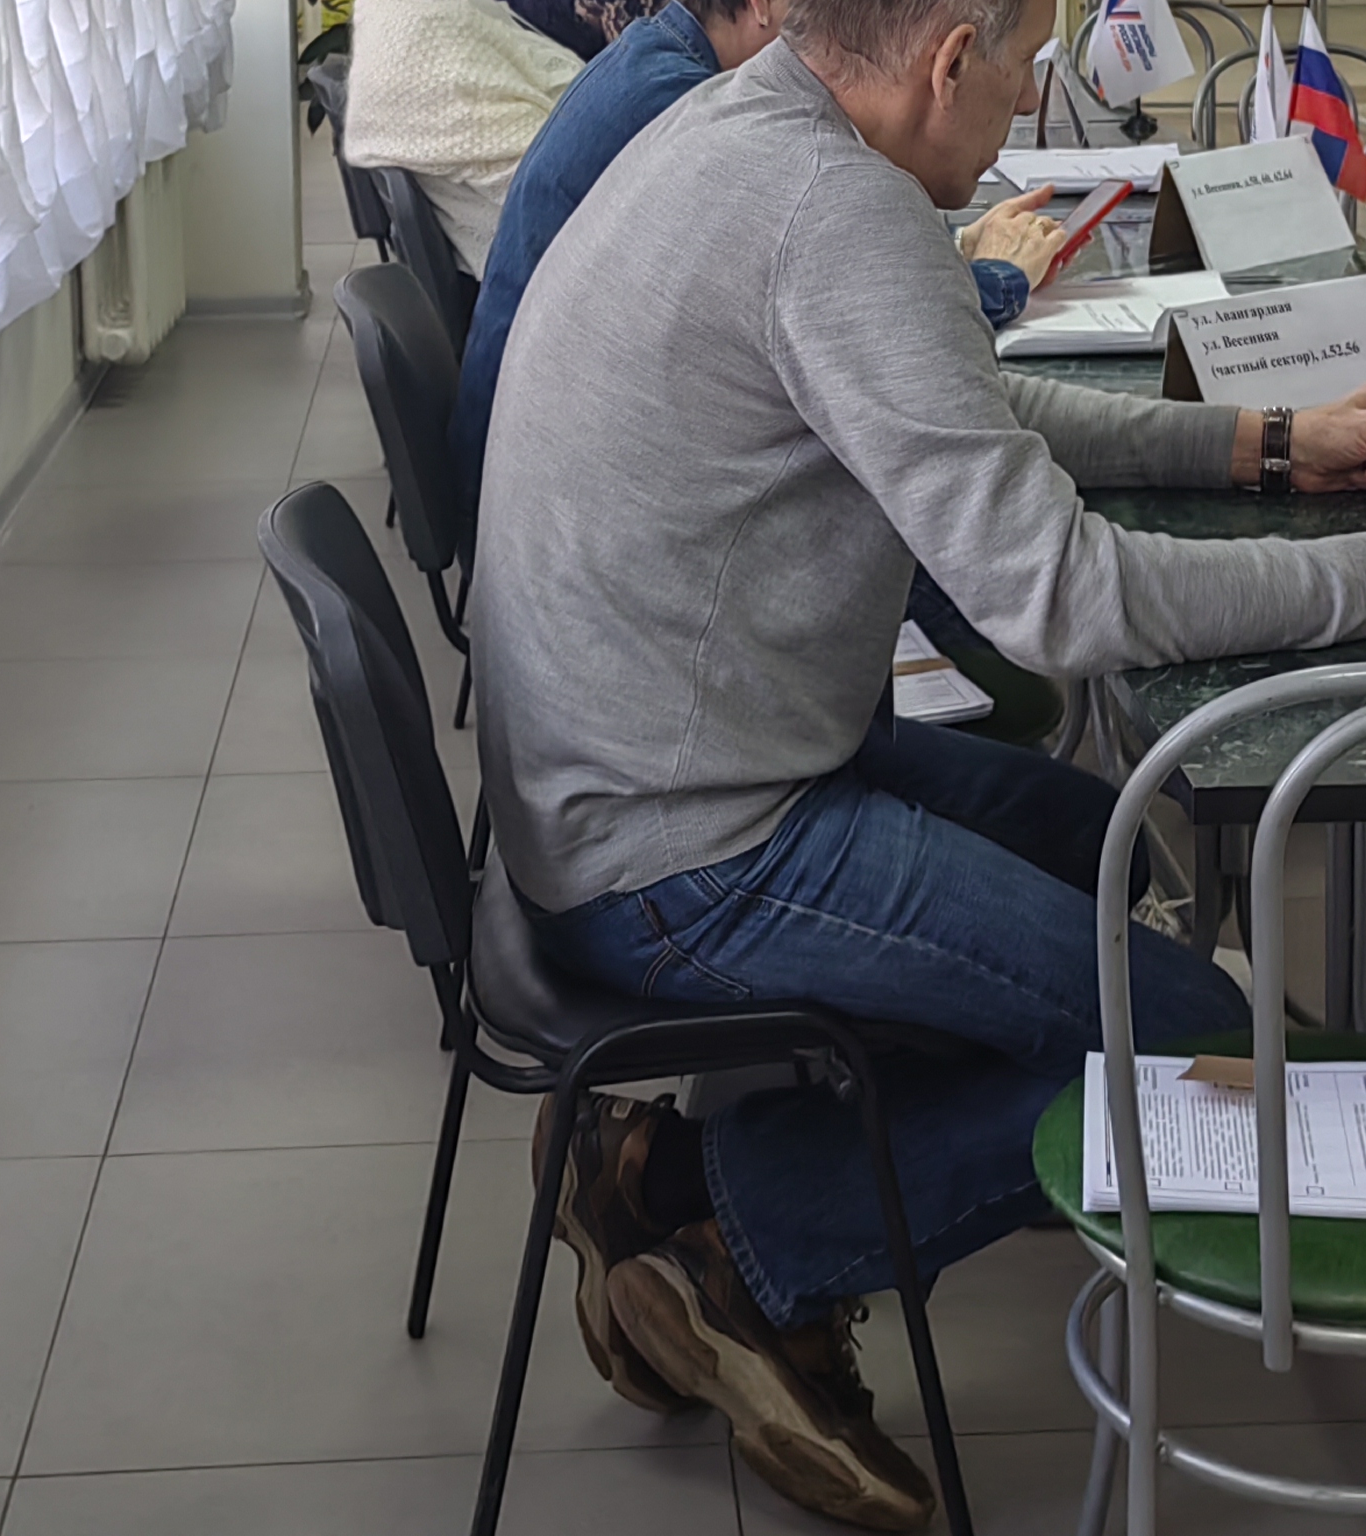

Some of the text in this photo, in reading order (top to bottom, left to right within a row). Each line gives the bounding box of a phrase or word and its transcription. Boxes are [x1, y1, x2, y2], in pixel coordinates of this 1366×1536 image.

[1191, 301, 1293, 331] ул. Авангардная
[1202, 330, 1281, 356] ул. Весенняя
[1210, 356, 1270, 380] (частный
[1269, 349, 1320, 368] сектор),
